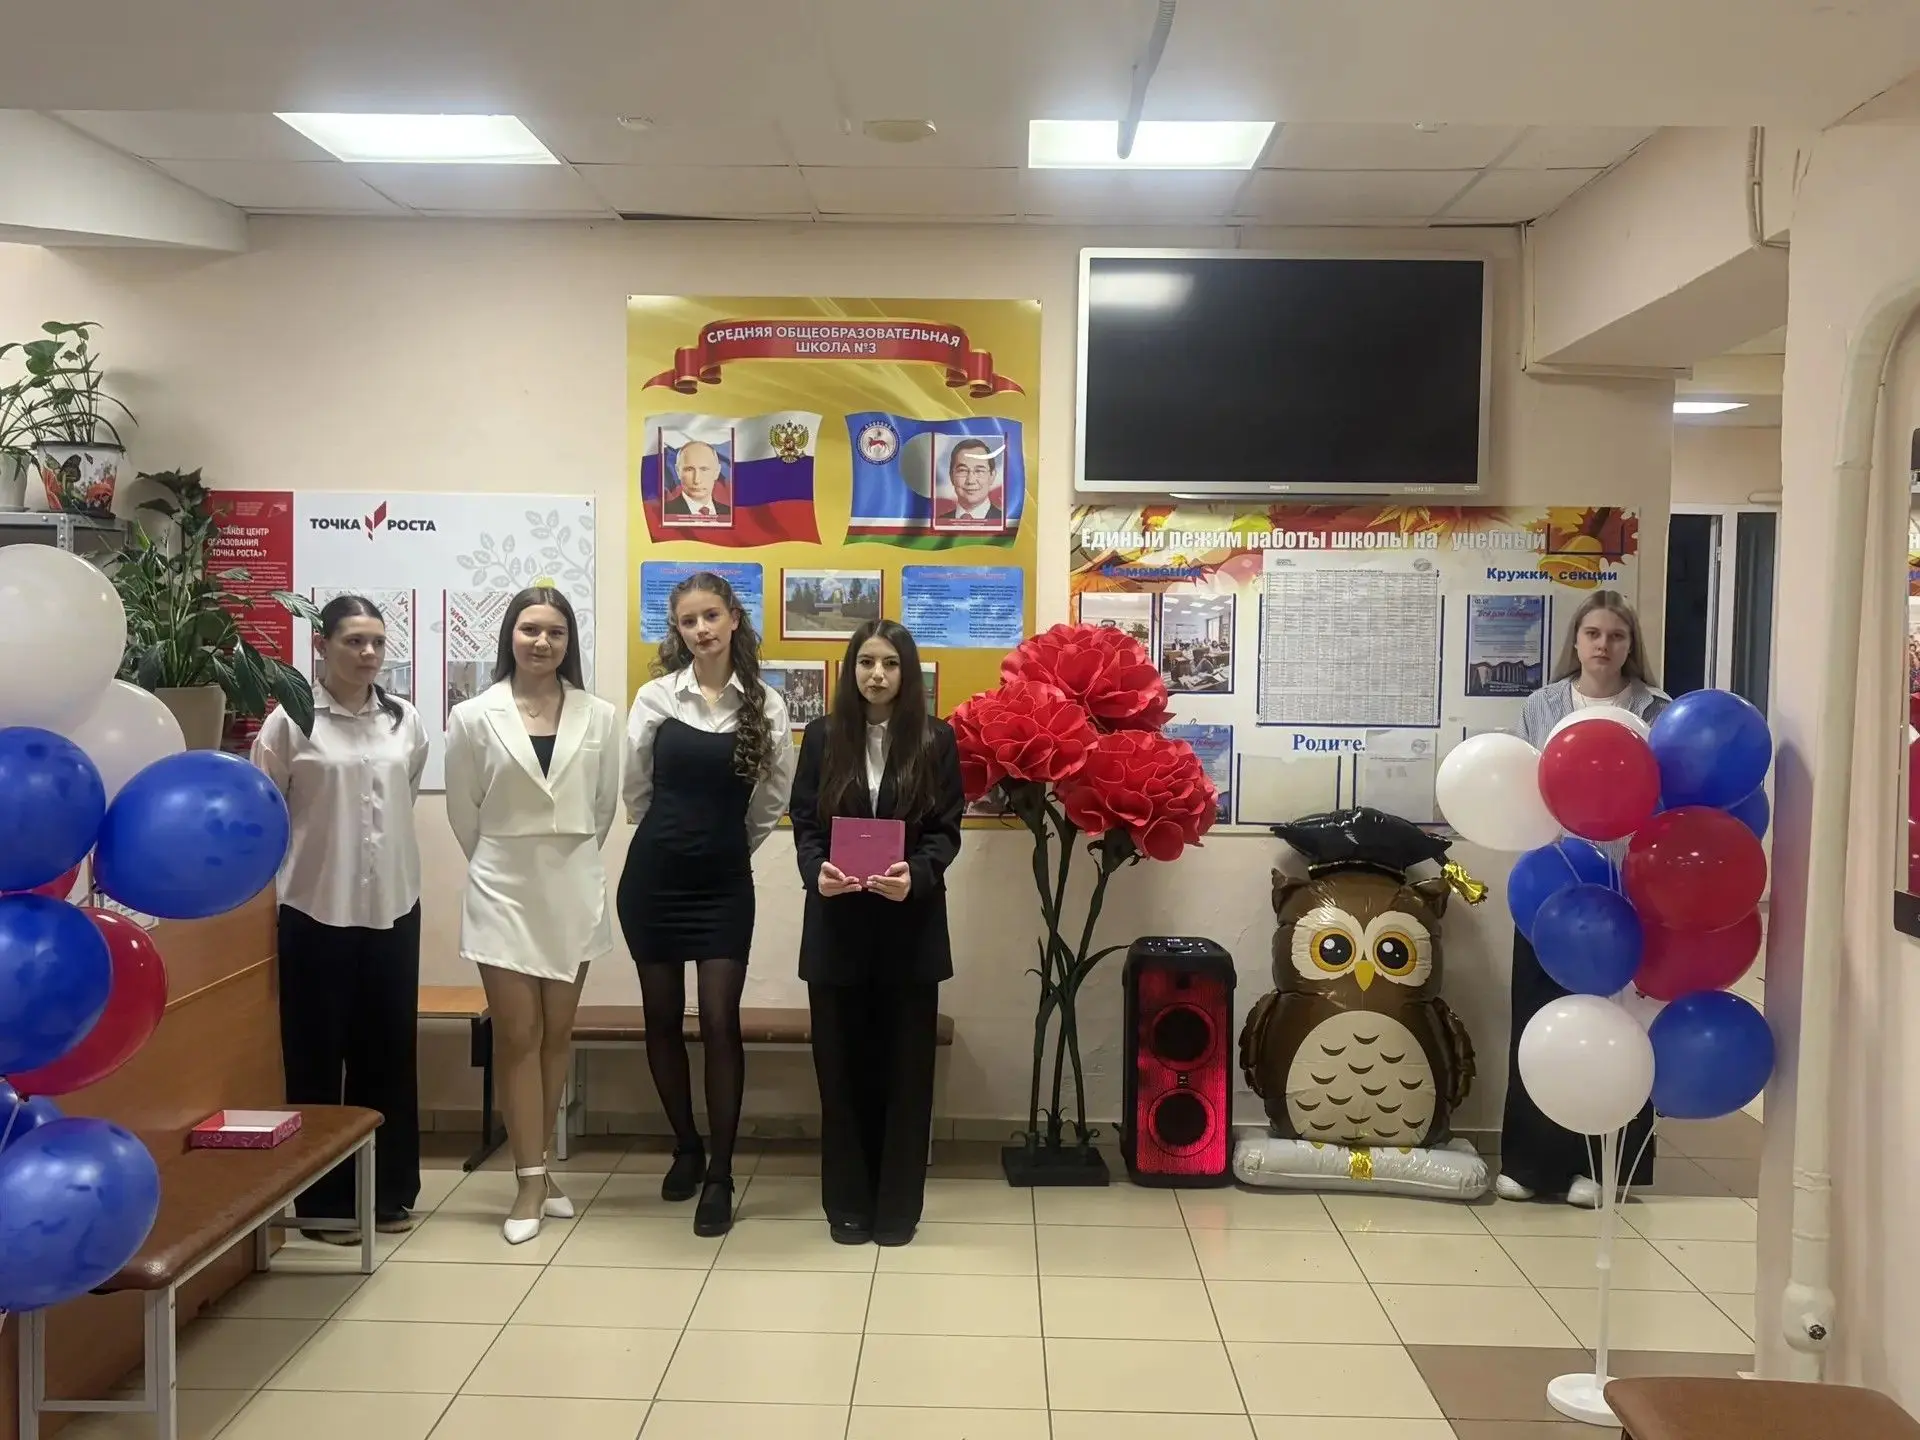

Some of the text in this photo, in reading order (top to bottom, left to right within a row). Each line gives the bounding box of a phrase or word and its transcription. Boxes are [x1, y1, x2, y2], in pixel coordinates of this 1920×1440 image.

[707, 326, 962, 348] СРЕДНЯЯ ОБЩЕОБРАЗОВАТЕЛЬНАЯ
[796, 341, 877, 354] ШКОЛА №3
[246, 527, 270, 537] ЦЕНТР
[310, 517, 437, 533] ТОЧКА РОСТА
[1082, 527, 1547, 551] Единый режим работы школы на учебный
[210, 549, 235, 557] ТОЧКА
[1486, 567, 1618, 583] Кружки, секции
[452, 625, 481, 652] расти
[1292, 733, 1366, 752] Родите
